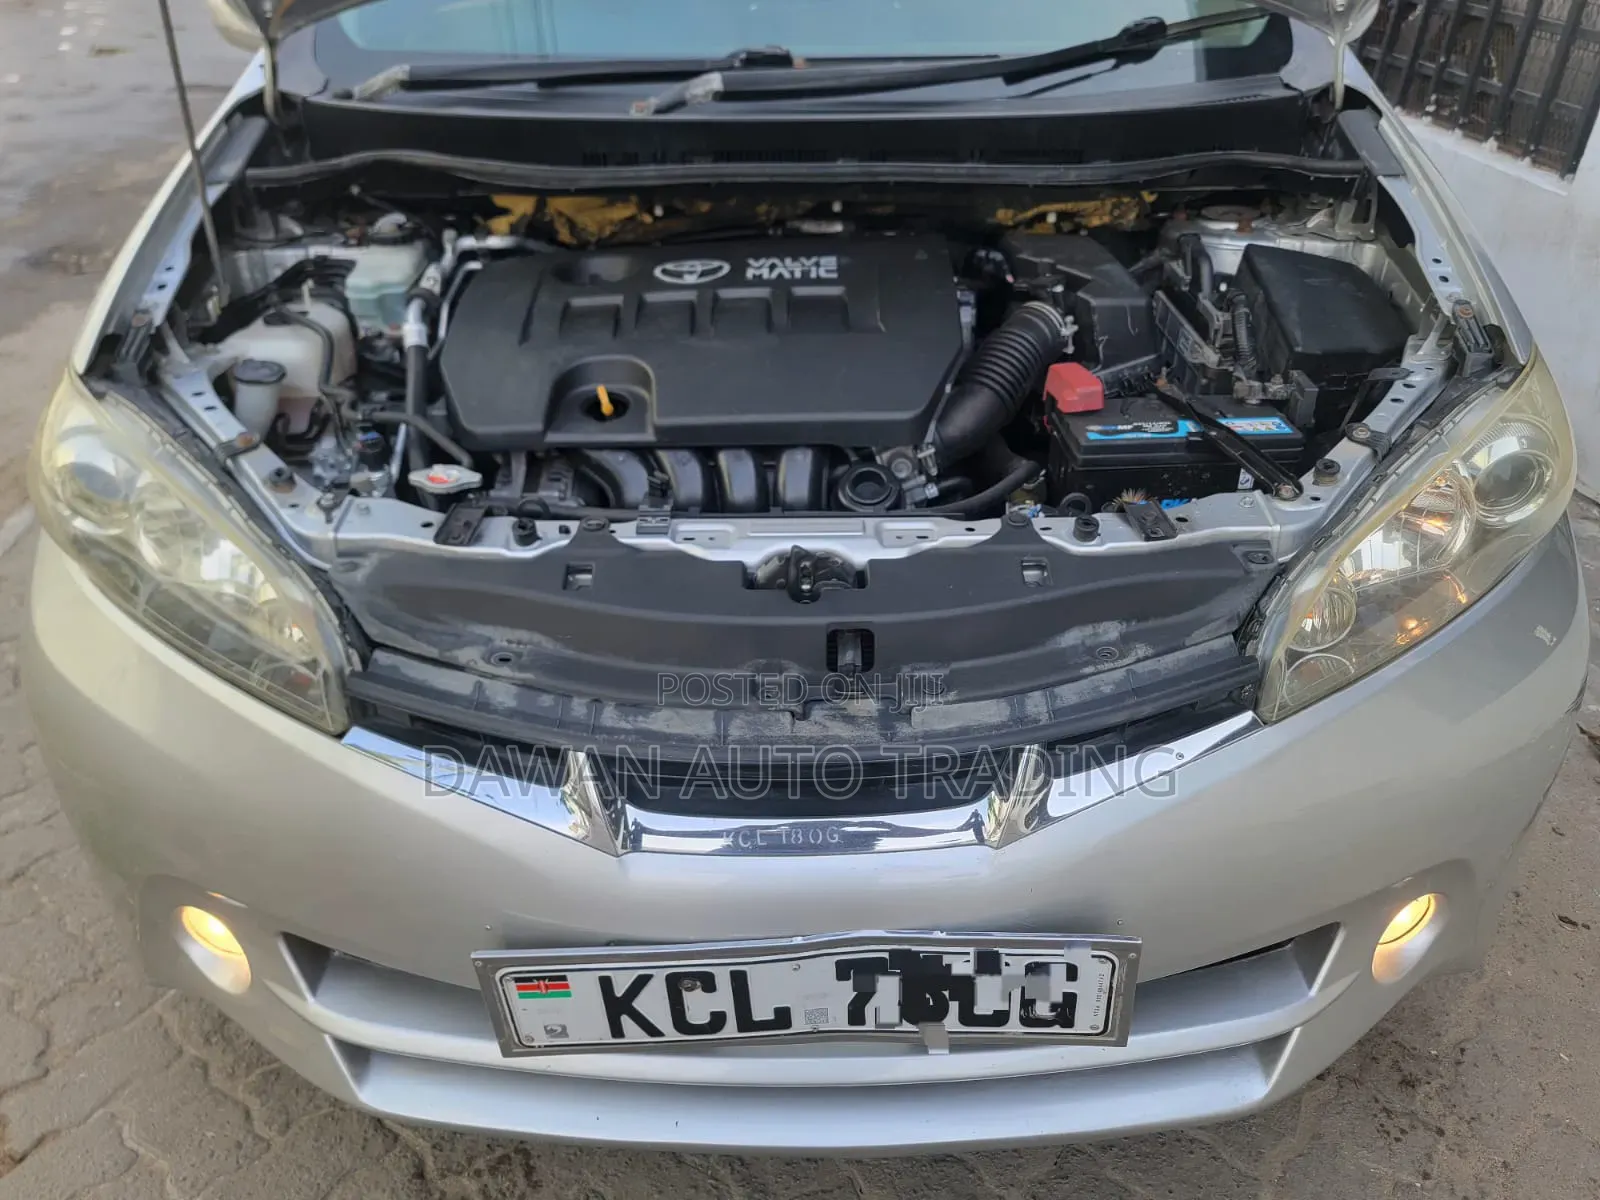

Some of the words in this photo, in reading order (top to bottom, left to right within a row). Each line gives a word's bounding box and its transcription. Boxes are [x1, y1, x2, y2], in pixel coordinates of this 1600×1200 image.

[746, 256, 838, 268] VALVE
[745, 267, 838, 280] MATIC
[598, 969, 793, 1039] KCL
